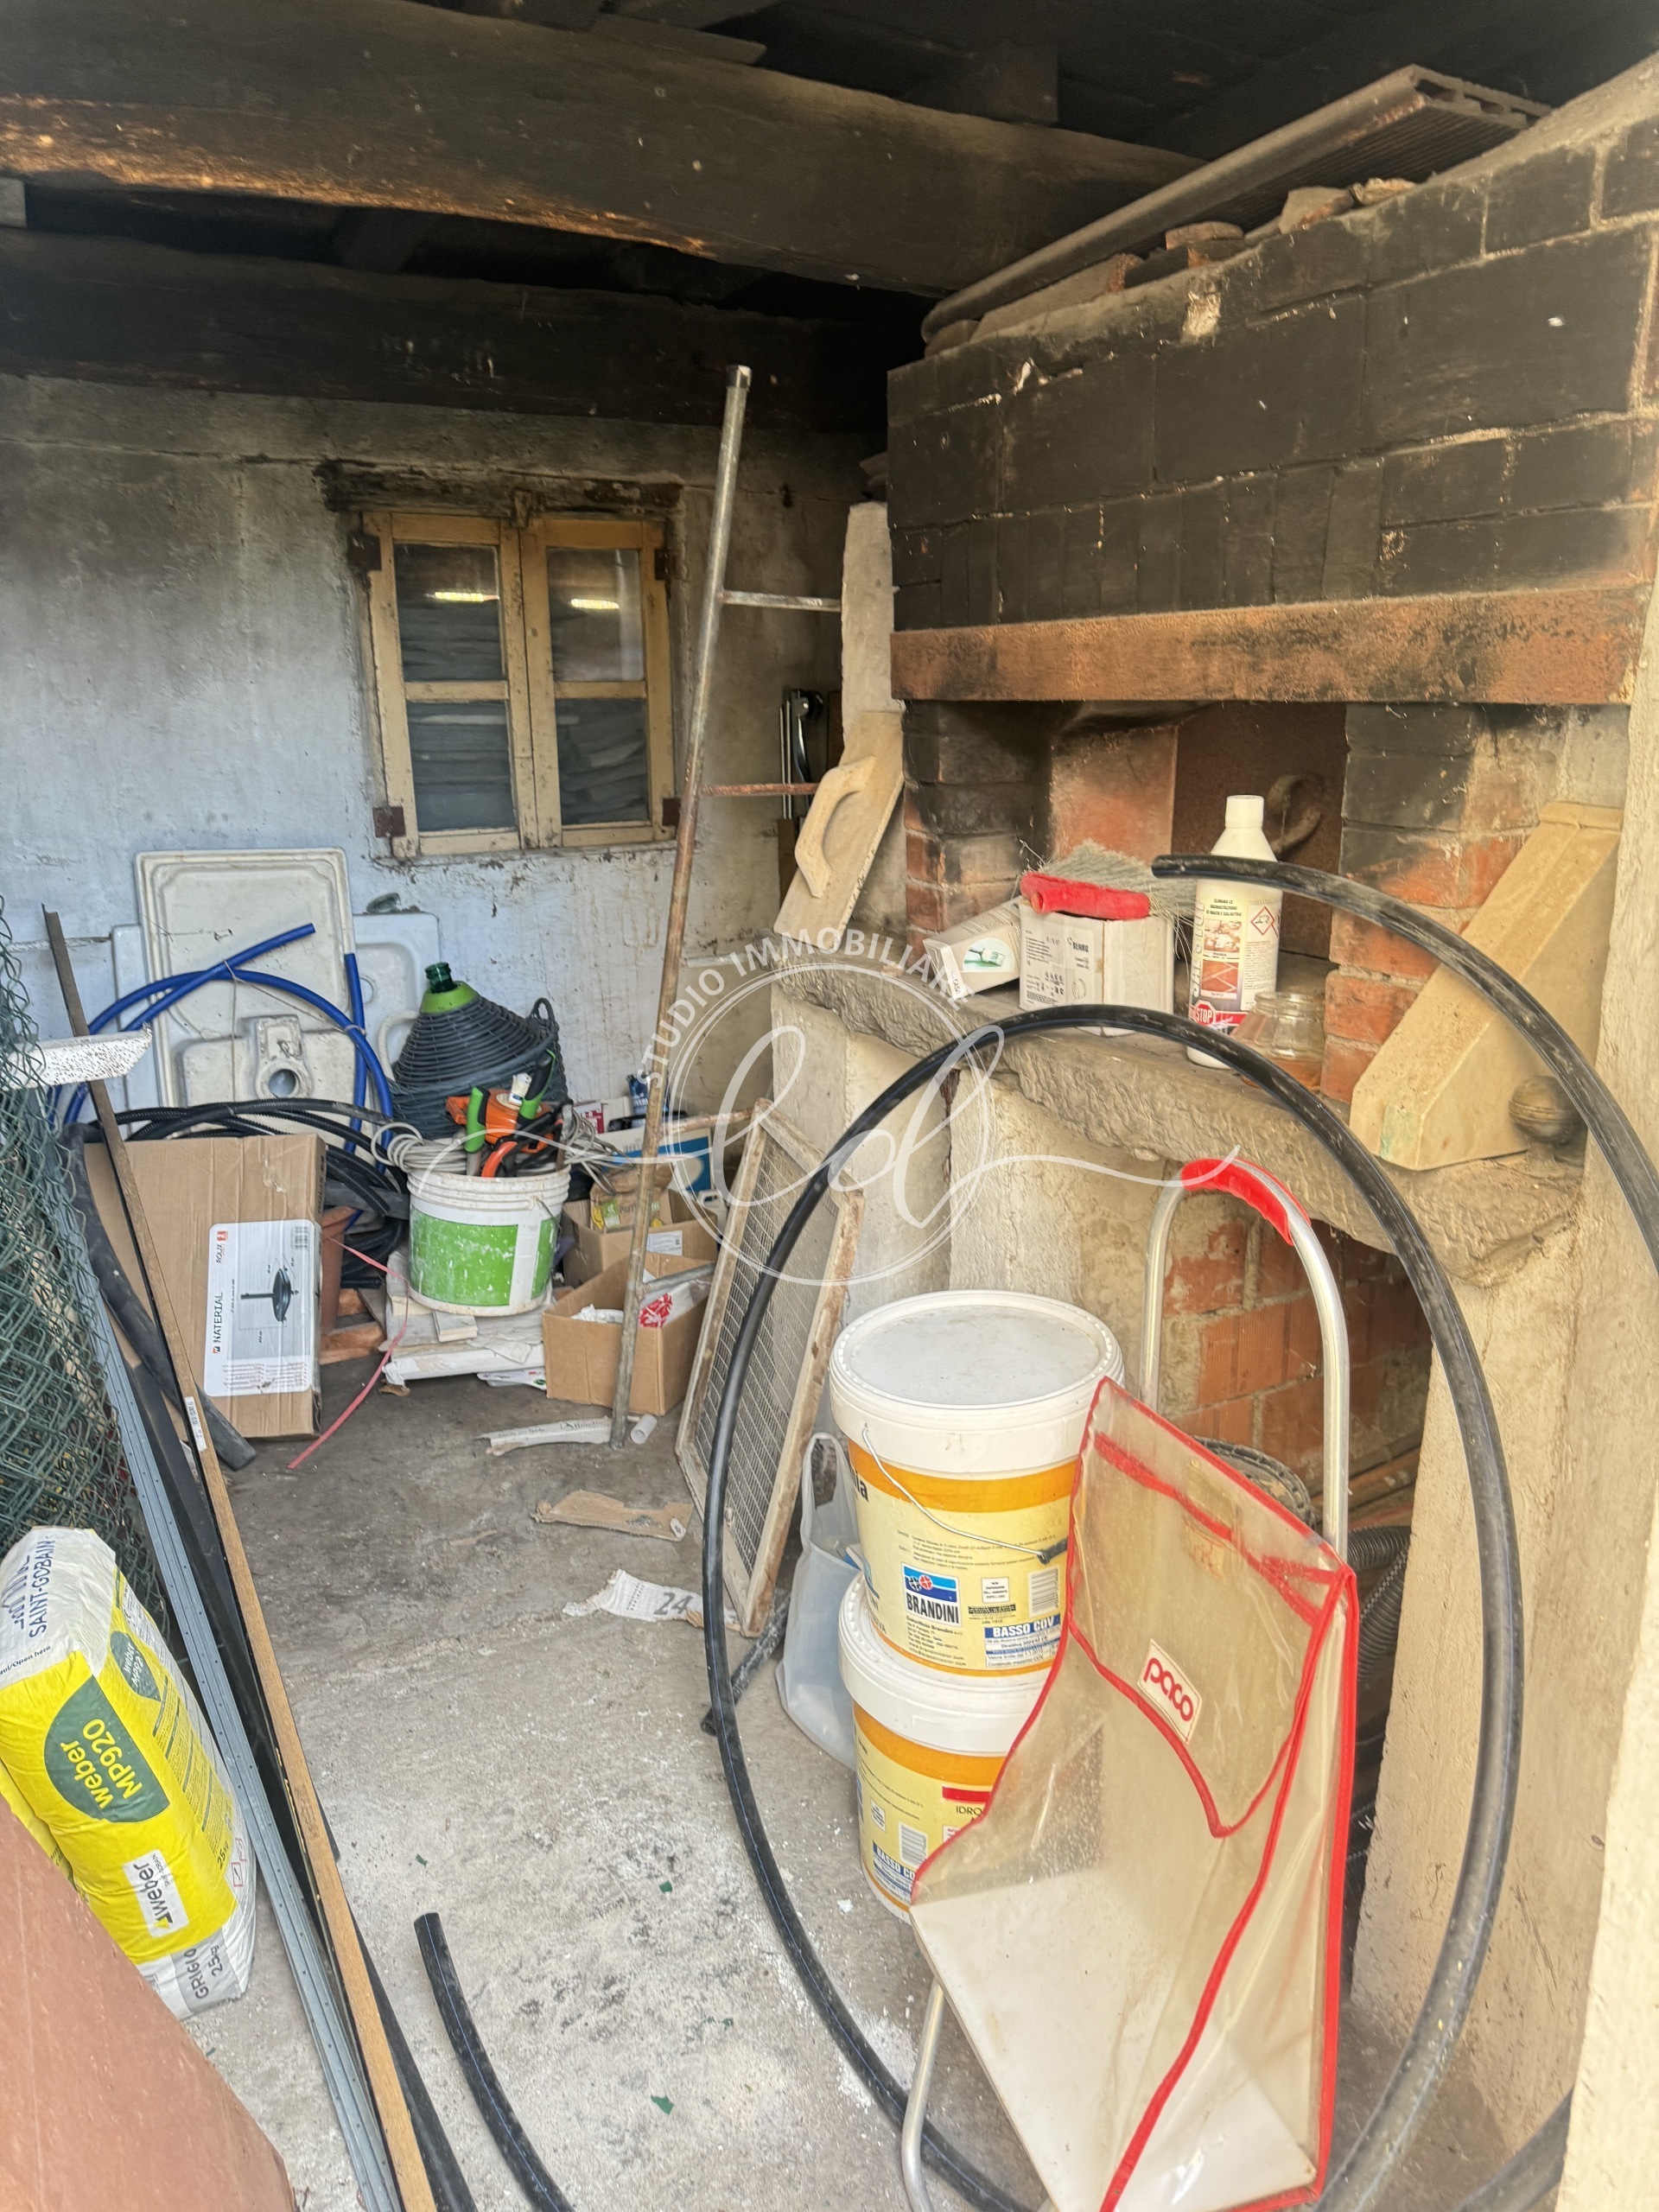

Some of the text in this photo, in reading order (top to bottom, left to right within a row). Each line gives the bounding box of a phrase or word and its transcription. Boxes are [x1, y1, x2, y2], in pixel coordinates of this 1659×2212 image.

[1195, 1008, 1212, 1025] STOP
[29, 1540, 55, 1638] SAINT-GOBAIN
[653, 1592, 694, 1616] 24
[906, 1592, 960, 1624] BRANDINI
[992, 1624, 1031, 1638] BASSO
[1033, 1615, 1055, 1632] COV
[130, 1649, 144, 1687] MP92
[1143, 1657, 1193, 1721] paco
[60, 1740, 114, 1809] weber
[82, 1719, 143, 1799] MP920
[956, 1805, 983, 1817] IDRO
[875, 1845, 916, 1881] BASSO CO
[133, 1862, 168, 1916] weber
[183, 1948, 209, 1999] GRIGIO
